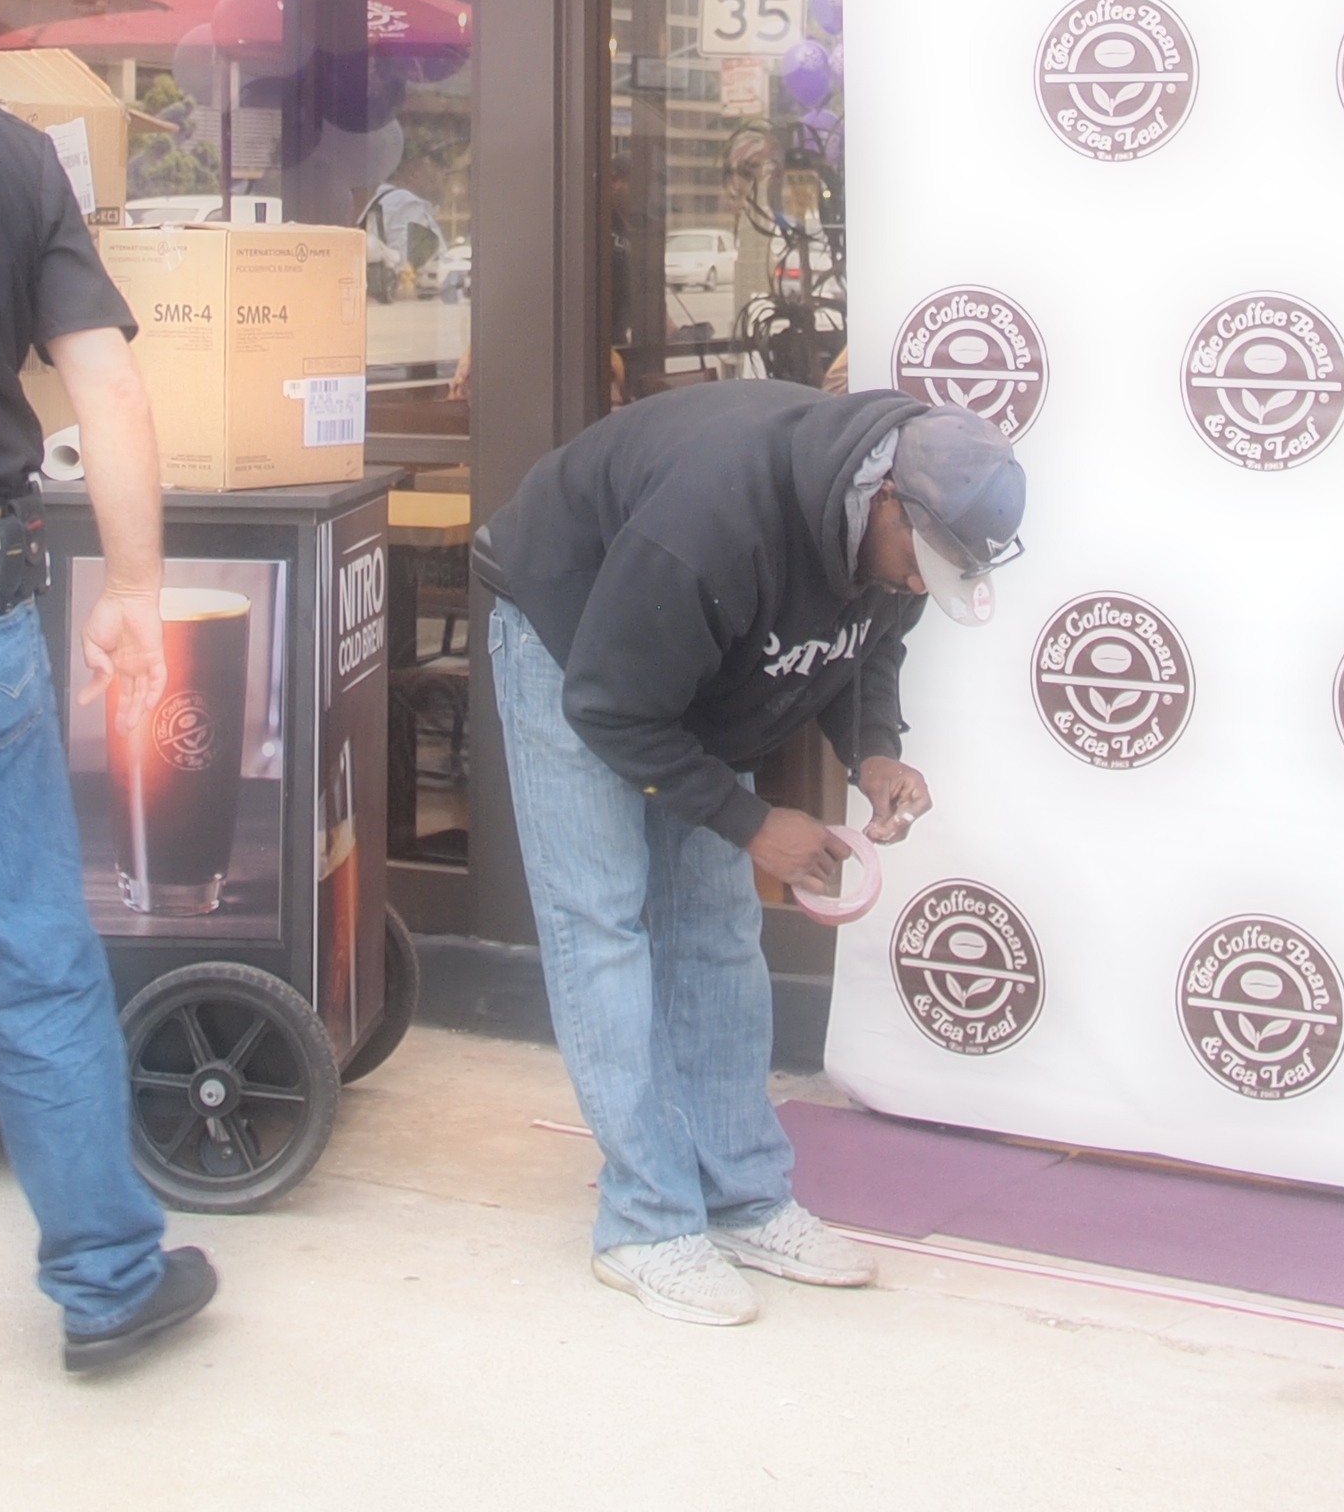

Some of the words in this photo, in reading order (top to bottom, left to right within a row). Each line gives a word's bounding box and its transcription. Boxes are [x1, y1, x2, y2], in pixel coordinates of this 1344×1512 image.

[1043, 32, 1074, 71] The
[1138, 5, 1180, 70] Bean
[1057, 108, 1078, 131] &
[1076, 119, 1112, 151] Tea
[1114, 106, 1168, 150] Leaf
[236, 249, 294, 257] INTERNATIONAL
[309, 249, 330, 257] PAPER
[153, 303, 212, 323] SMR-4
[236, 305, 288, 325] SMR-4
[900, 327, 930, 364] The
[924, 295, 989, 330] Coffee
[991, 304, 1031, 369] Bean
[1190, 335, 1223, 374] The
[1217, 301, 1288, 339] Coffee
[1290, 311, 1333, 379] Bean
[1204, 414, 1226, 437] &
[1224, 426, 1262, 460] Tea
[1264, 416, 1320, 460] Leaf
[339, 547, 384, 635] NITRO
[339, 631, 361, 676] COLD
[362, 615, 384, 660] BREW
[1040, 632, 1071, 670] The
[1065, 601, 1133, 637] Coffee
[1134, 612, 1176, 681] Bean
[1054, 710, 1074, 734] &
[1073, 723, 1109, 758] Tea
[1111, 717, 1164, 759] Leaf
[900, 917, 928, 954] The
[923, 889, 986, 922] Coffee
[988, 902, 1027, 971] Bean
[1187, 955, 1219, 994] The
[1213, 925, 1284, 960] Coffee
[1286, 938, 1329, 1011] Bean
[913, 994, 932, 1017] &
[931, 1007, 965, 1043] Tea
[966, 1005, 1016, 1044] Leaf
[1200, 1036, 1222, 1060] &
[1220, 1049, 1258, 1087] Tea
[1260, 1047, 1316, 1089] Leaf
